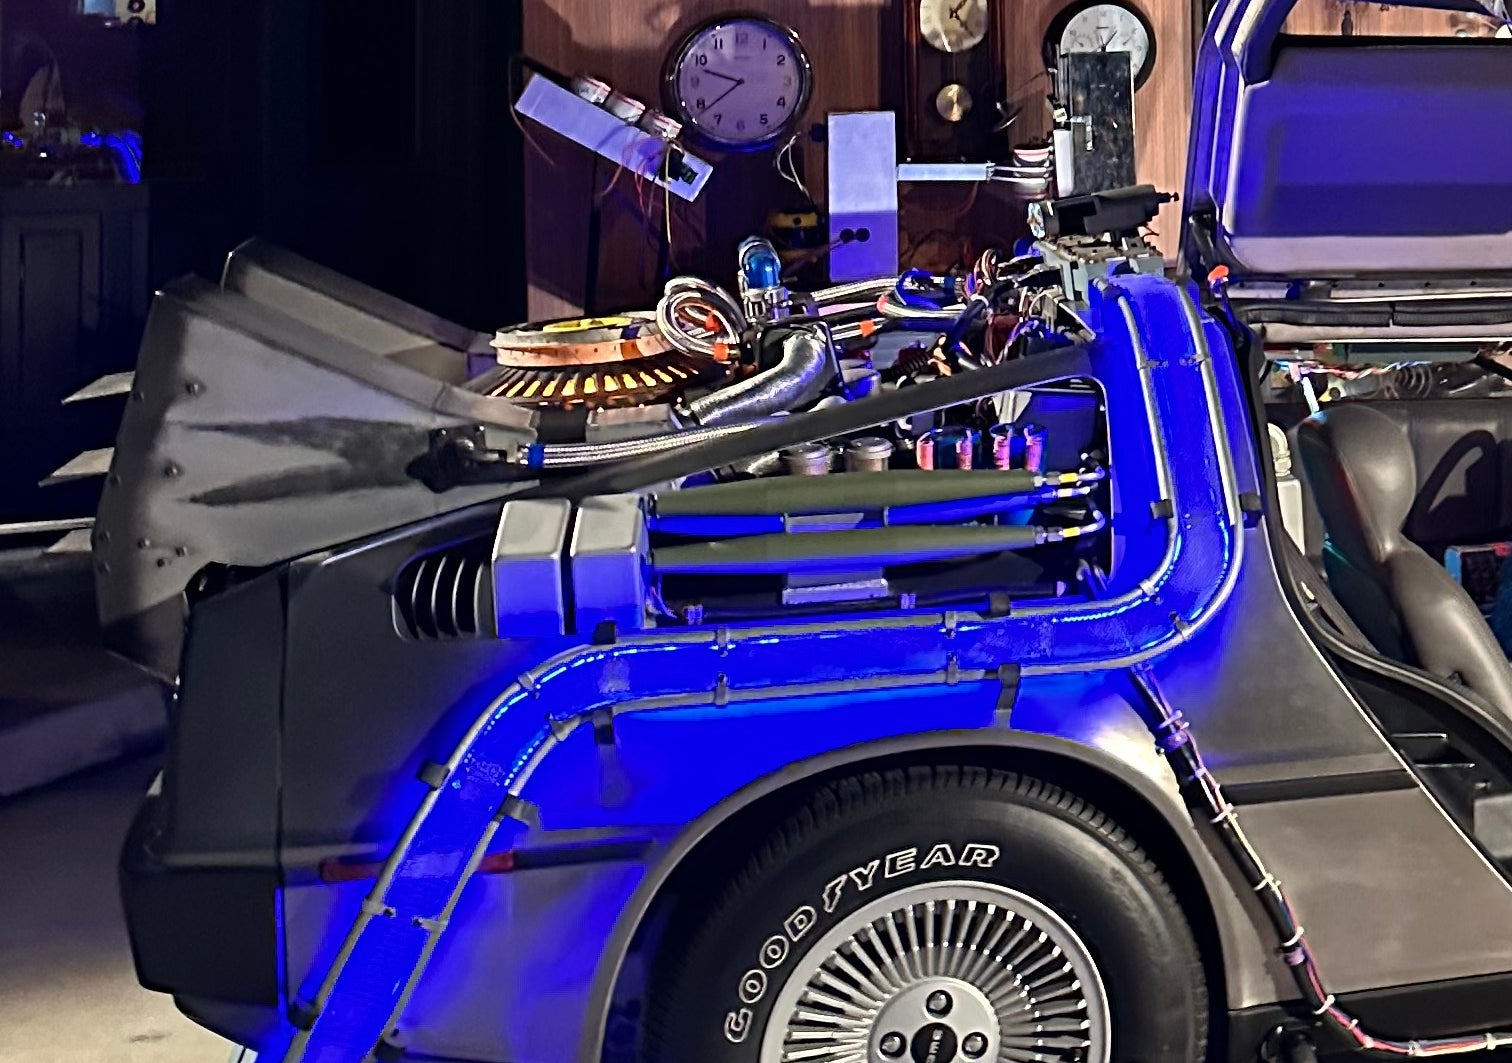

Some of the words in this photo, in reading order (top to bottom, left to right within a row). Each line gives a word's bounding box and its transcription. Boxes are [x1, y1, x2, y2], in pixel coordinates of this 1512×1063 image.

[714, 37, 723, 50] 11
[695, 54, 708, 66] 10
[776, 54, 786, 66] 2
[697, 98, 706, 109] 8
[776, 96, 786, 108] 4
[714, 114, 722, 125] 7
[759, 113, 768, 125] 5
[723, 843, 1000, 1043] GOODYEAR
